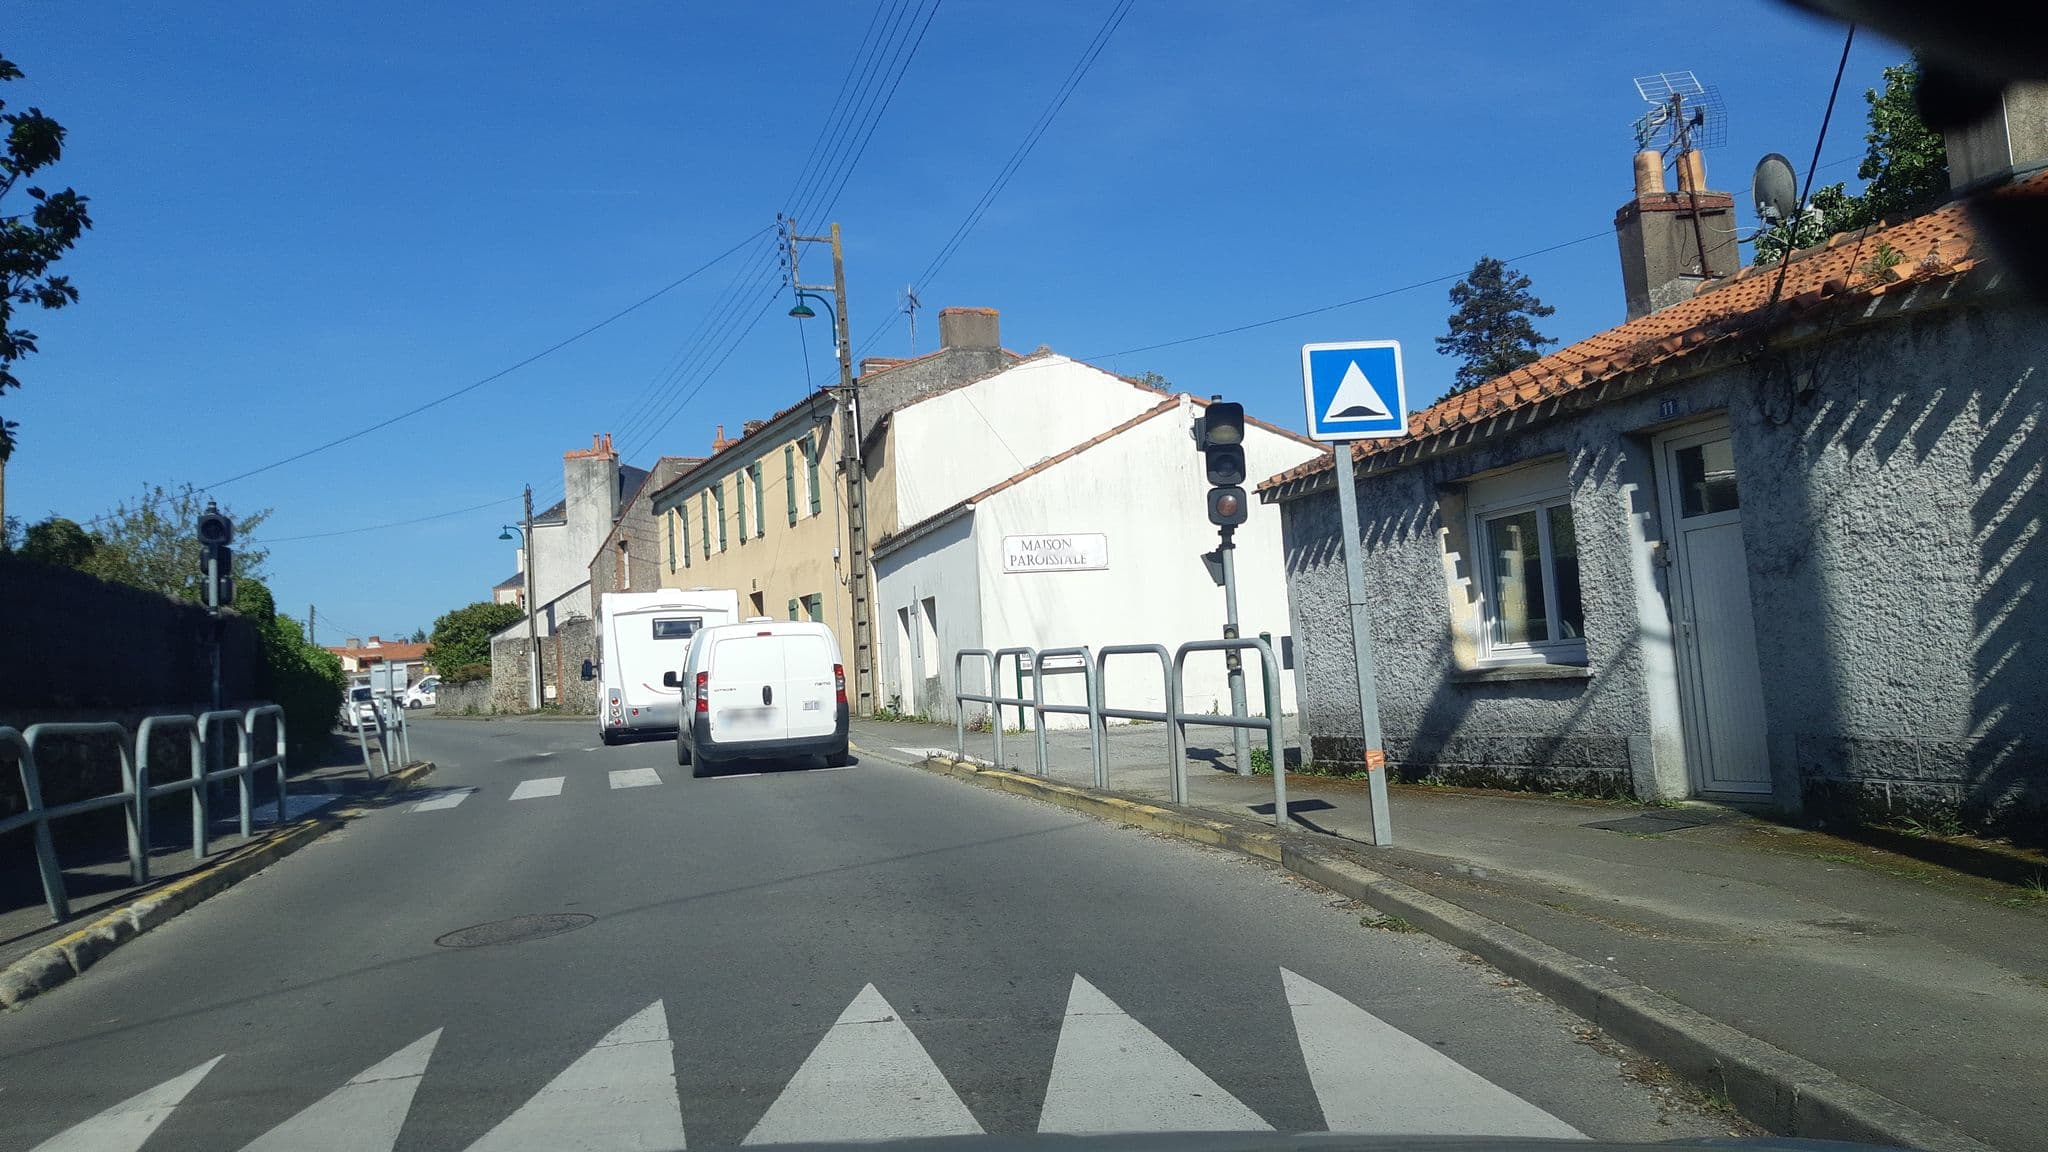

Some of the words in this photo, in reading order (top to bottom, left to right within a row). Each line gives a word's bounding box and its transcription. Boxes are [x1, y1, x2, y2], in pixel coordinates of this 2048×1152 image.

[1663, 401, 1673, 415] 11
[1021, 538, 1071, 551] MAISON
[1010, 554, 1087, 567] PAROISSIALE
